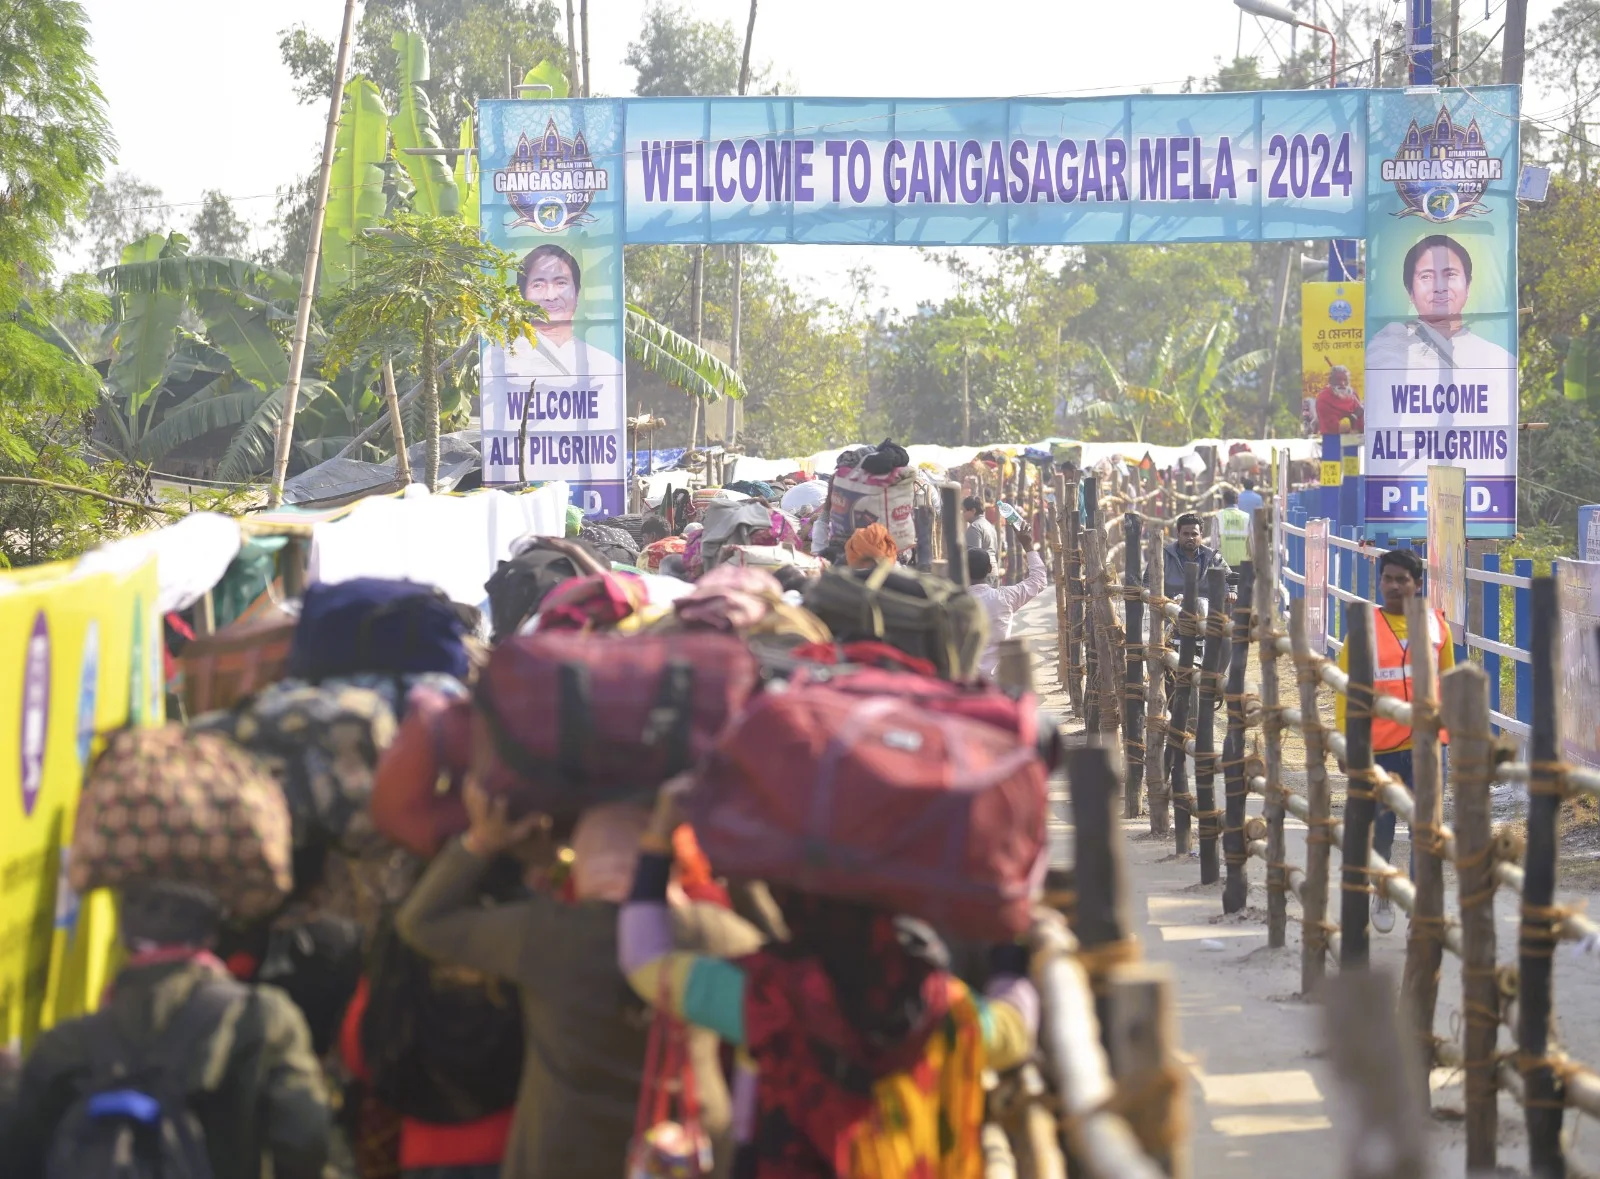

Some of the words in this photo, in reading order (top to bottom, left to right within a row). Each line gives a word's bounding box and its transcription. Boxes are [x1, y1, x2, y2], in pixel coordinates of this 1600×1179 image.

[495, 170, 608, 192] GANGASAGAR
[640, 139, 815, 203] WELCOME
[825, 139, 872, 203] TO
[883, 138, 1129, 204] GANGASAGAR
[1139, 136, 1237, 201] MELA
[1247, 168, 1258, 183] -
[1267, 132, 1353, 199] 2024
[1382, 160, 1501, 180] GANGASAGAR
[566, 192, 589, 203] 2024
[1457, 182, 1482, 193] 2024
[507, 391, 599, 420] WELCOME
[1391, 384, 1488, 414] WELCOME
[529, 434, 617, 465] PILGRIMS
[1371, 430, 1408, 460] ALL
[1414, 429, 1508, 460] PILGRIMS
